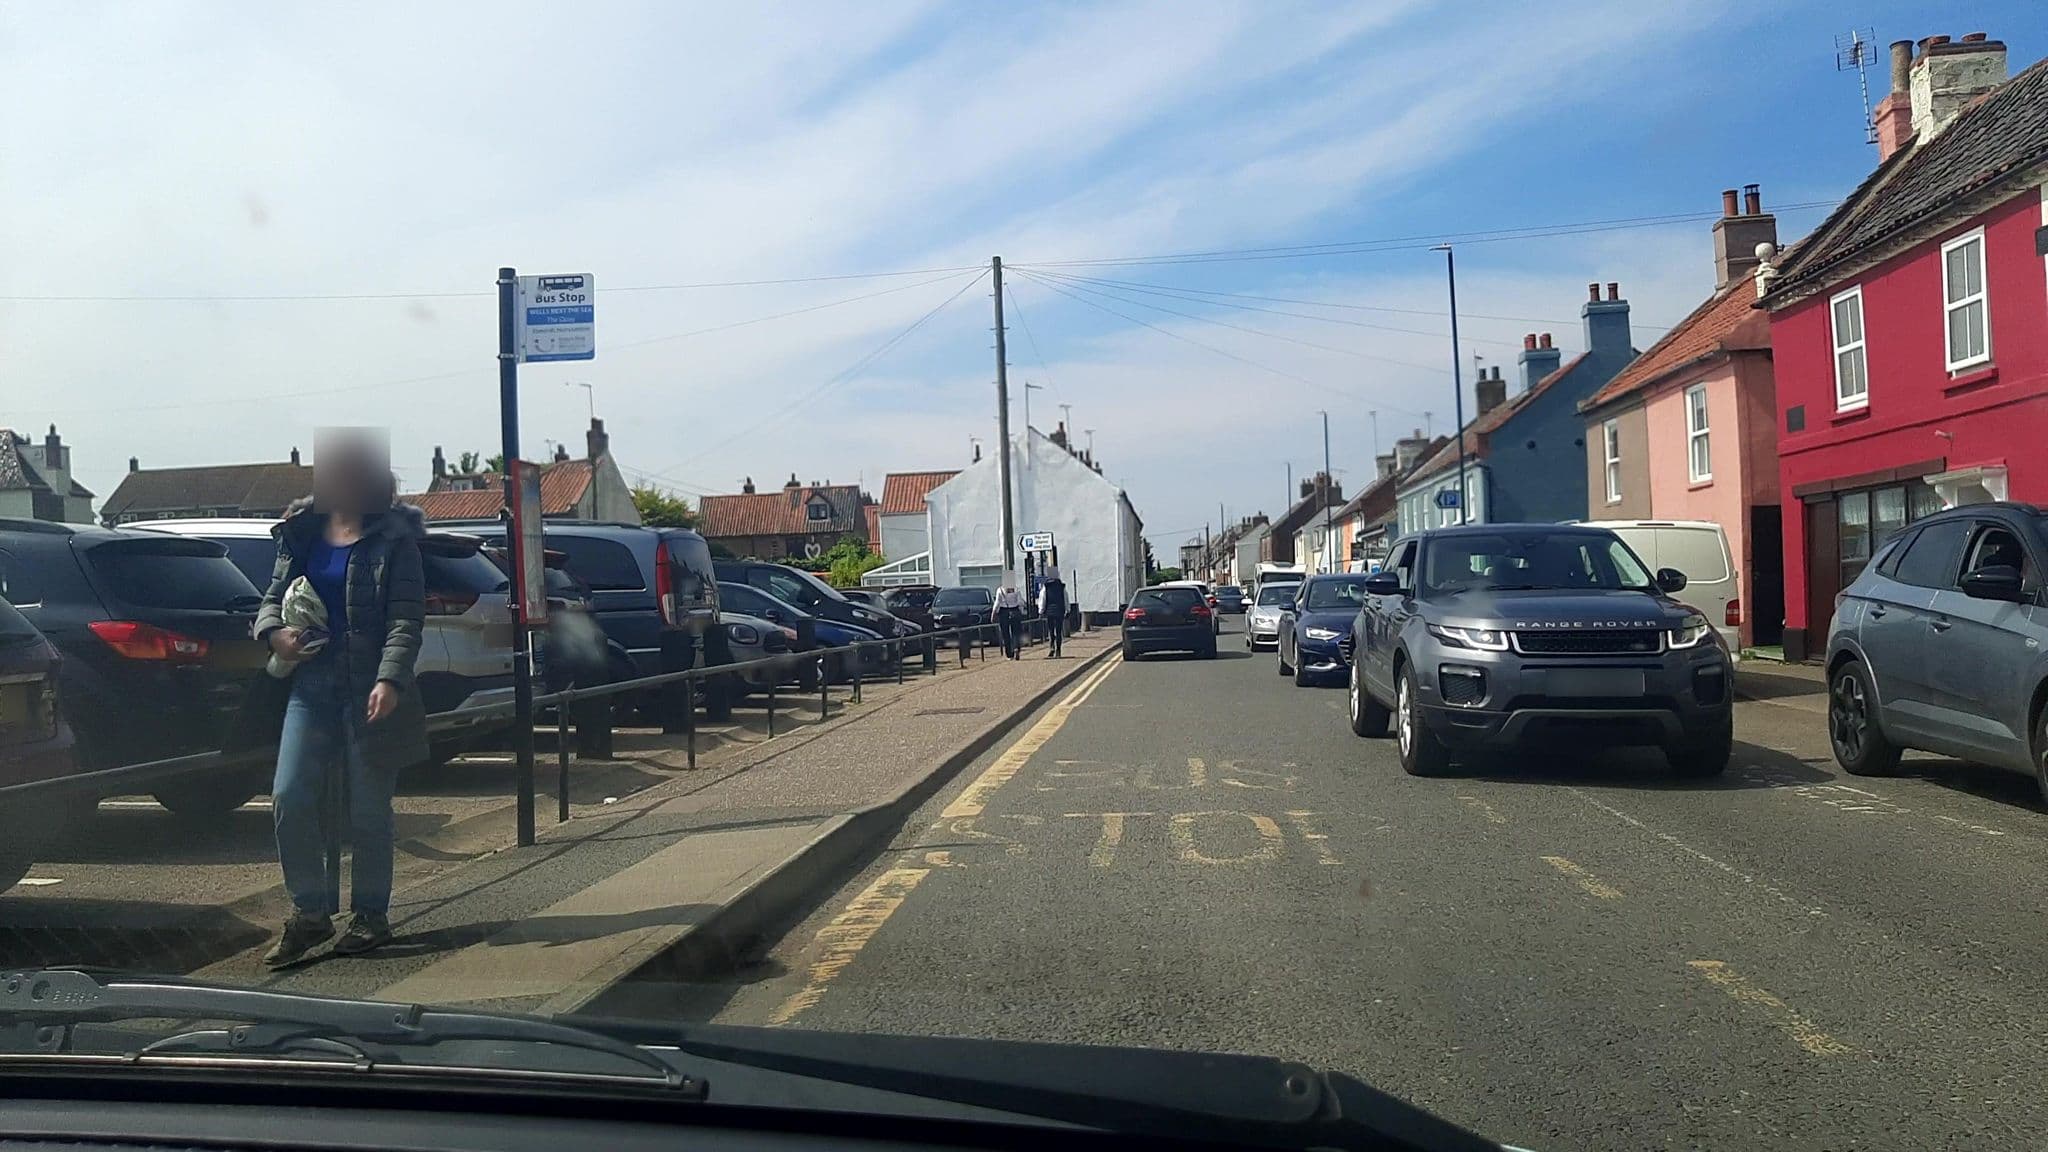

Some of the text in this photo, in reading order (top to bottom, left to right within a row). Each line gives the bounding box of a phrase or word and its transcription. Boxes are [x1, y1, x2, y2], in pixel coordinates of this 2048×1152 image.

[535, 292, 585, 303] Bus Stop
[1446, 494, 1455, 504] P
[1593, 620, 1657, 628] ROVER
